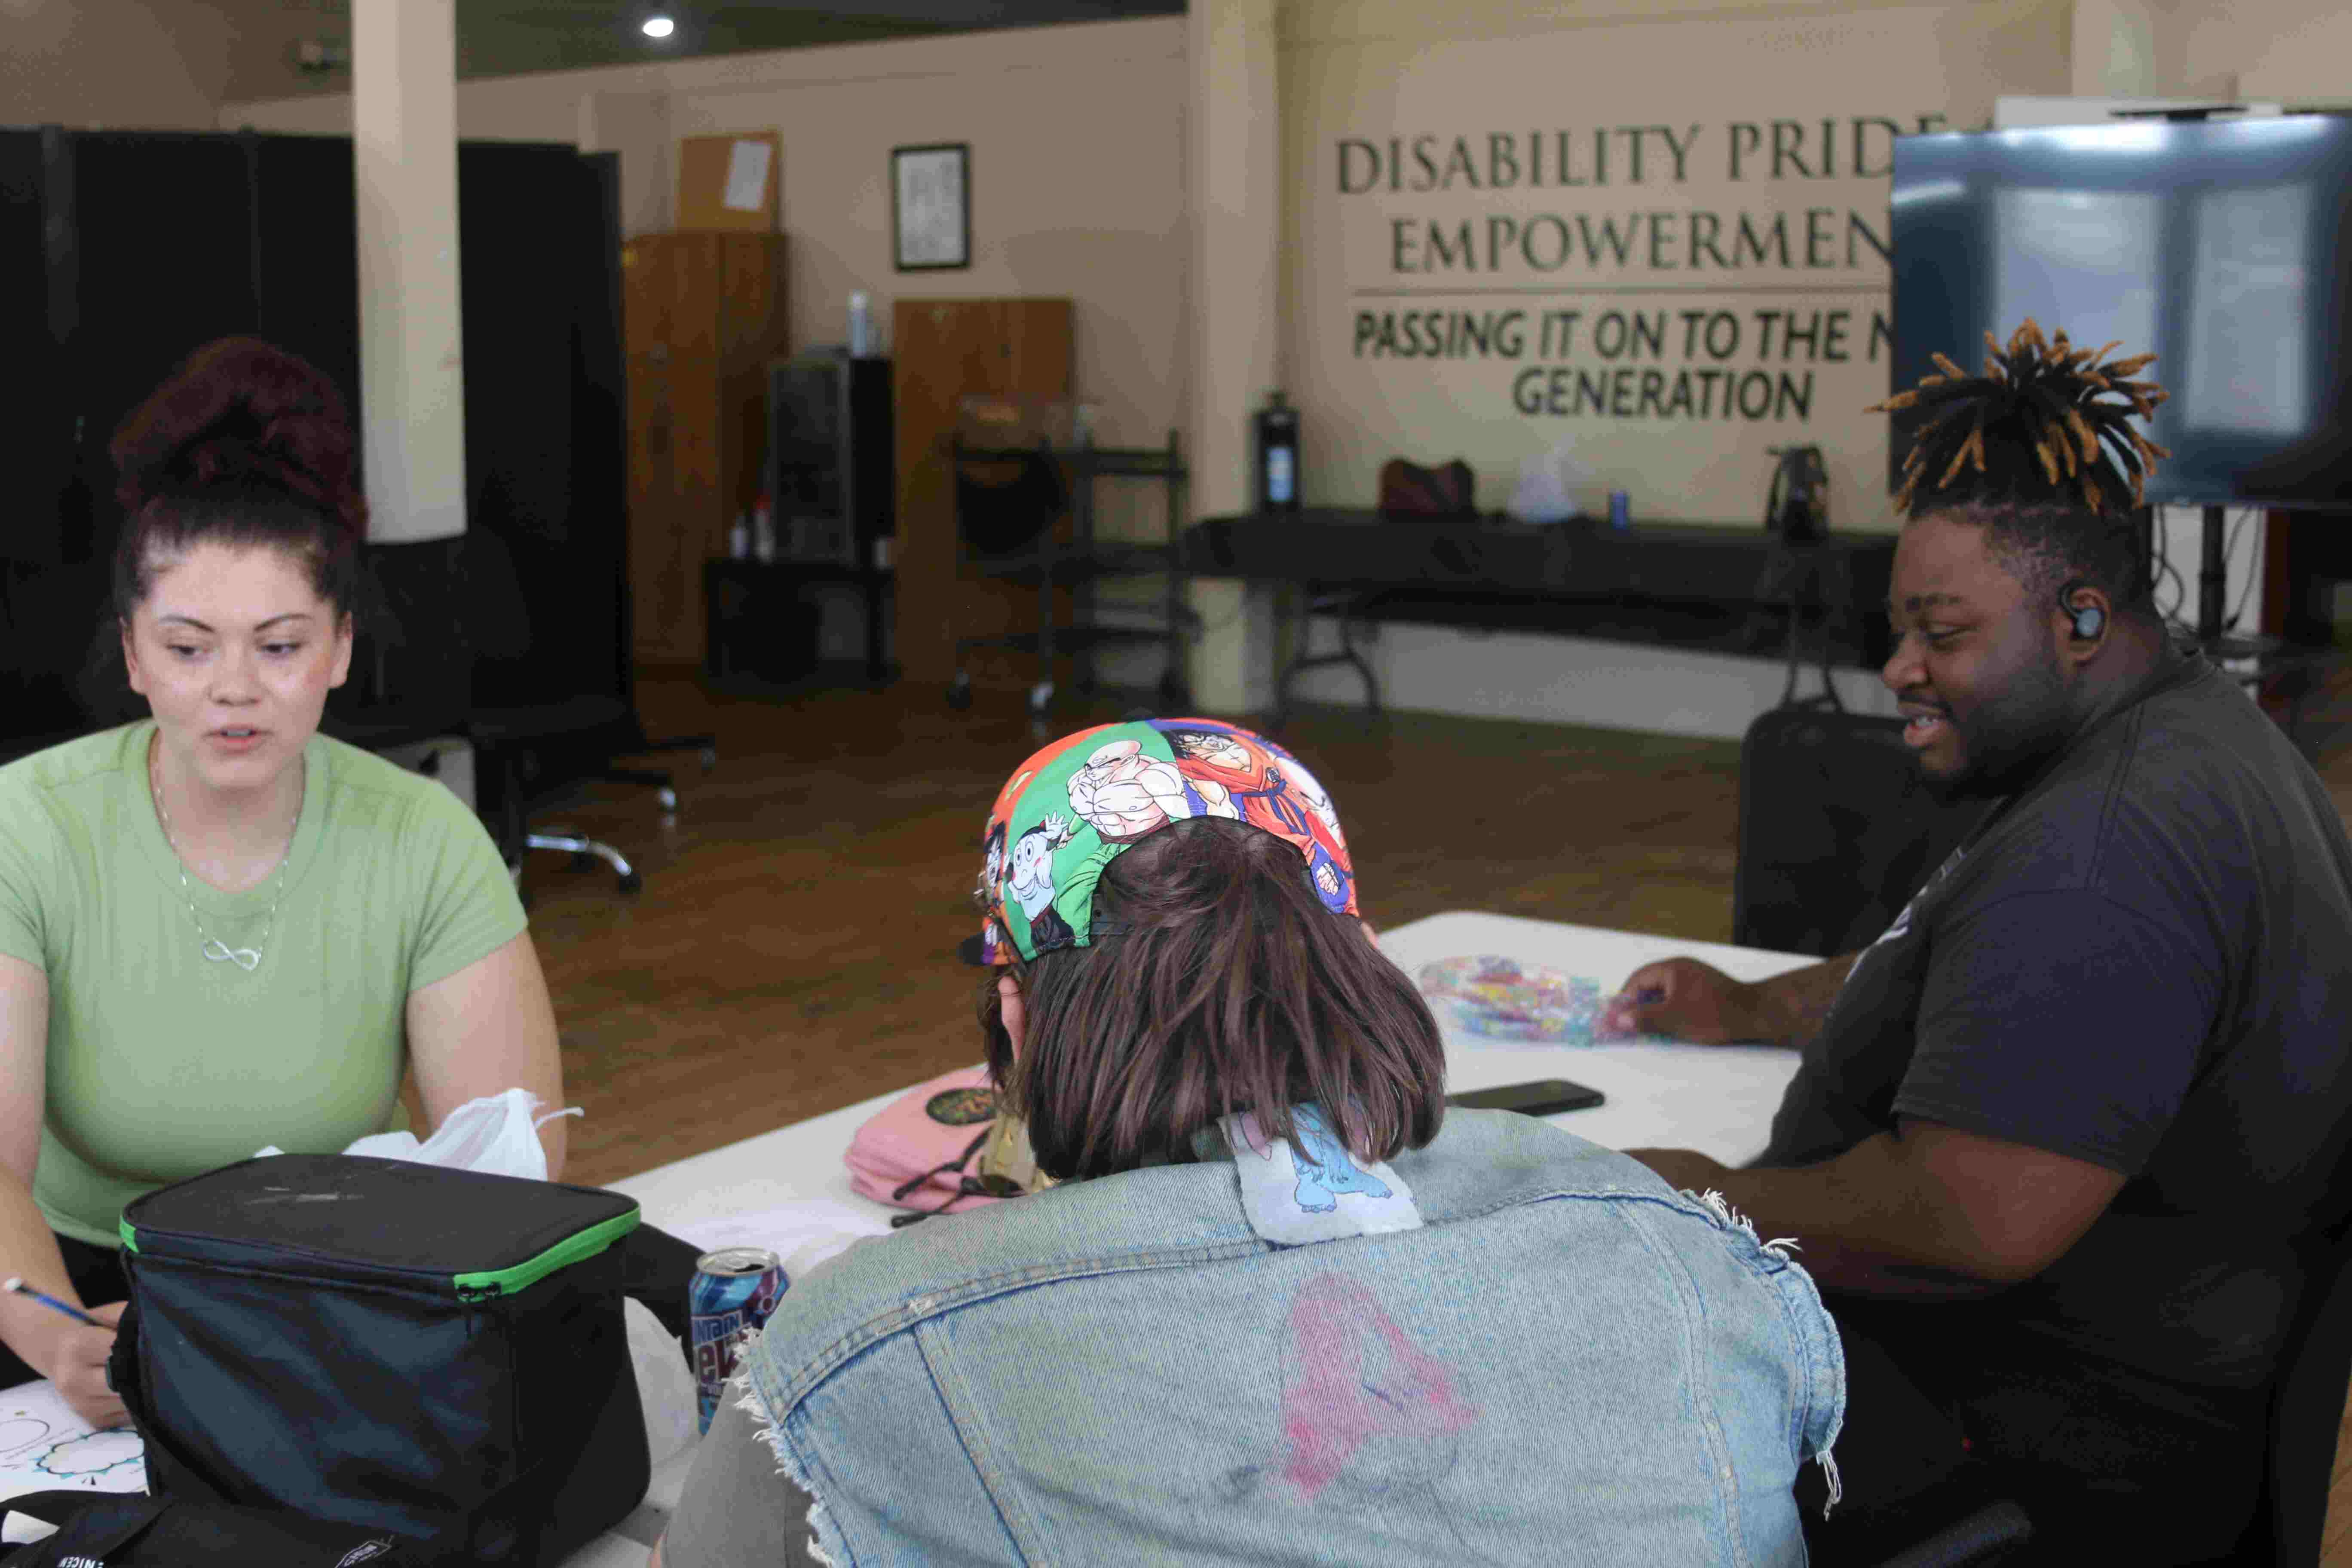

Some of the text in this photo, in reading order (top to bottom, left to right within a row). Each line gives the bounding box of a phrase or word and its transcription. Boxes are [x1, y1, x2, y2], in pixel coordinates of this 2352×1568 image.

[1335, 122, 1702, 194] DISABILITY
[1390, 207, 1892, 274] EMPOWERMEN
[1353, 308, 1527, 359] PASSING
[1540, 308, 1582, 359] IT
[1595, 308, 1669, 361] ON
[1678, 307, 1741, 361] TO
[1752, 308, 1850, 363] THE
[1513, 365, 1815, 421] GENERATION
